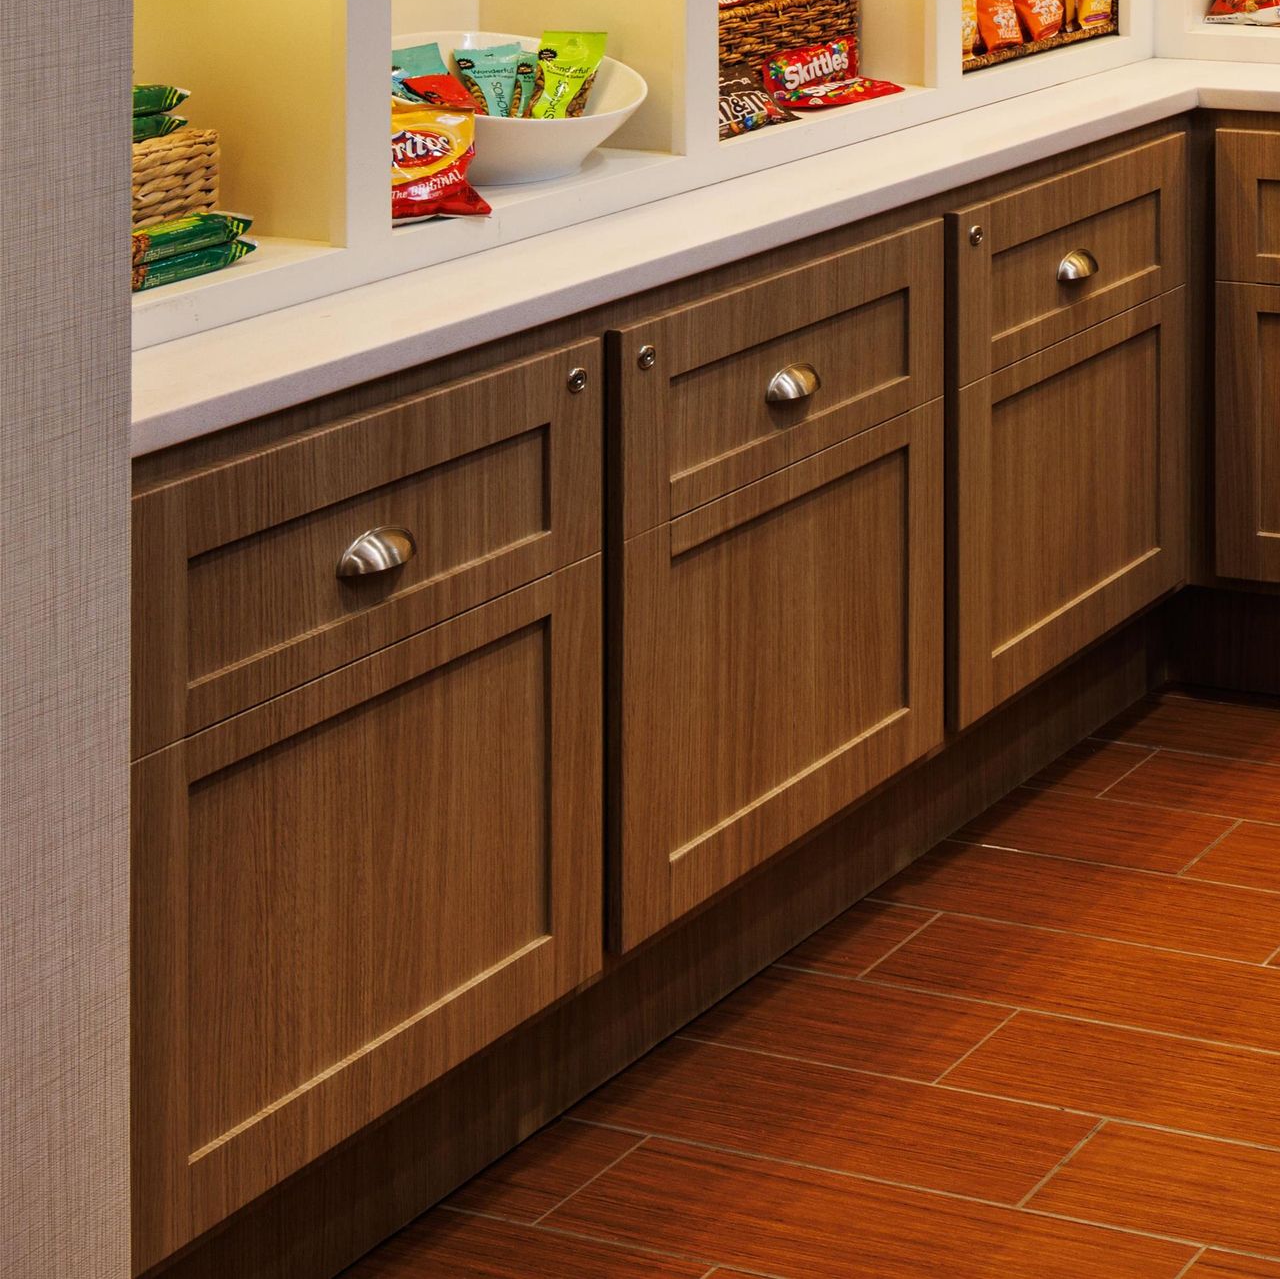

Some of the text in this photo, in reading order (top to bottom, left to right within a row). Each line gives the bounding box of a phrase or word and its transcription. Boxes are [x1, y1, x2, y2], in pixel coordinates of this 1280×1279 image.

[470, 67, 515, 75] Wonderful
[784, 51, 849, 90] Skittles
[410, 169, 465, 196] ORIGINAL
